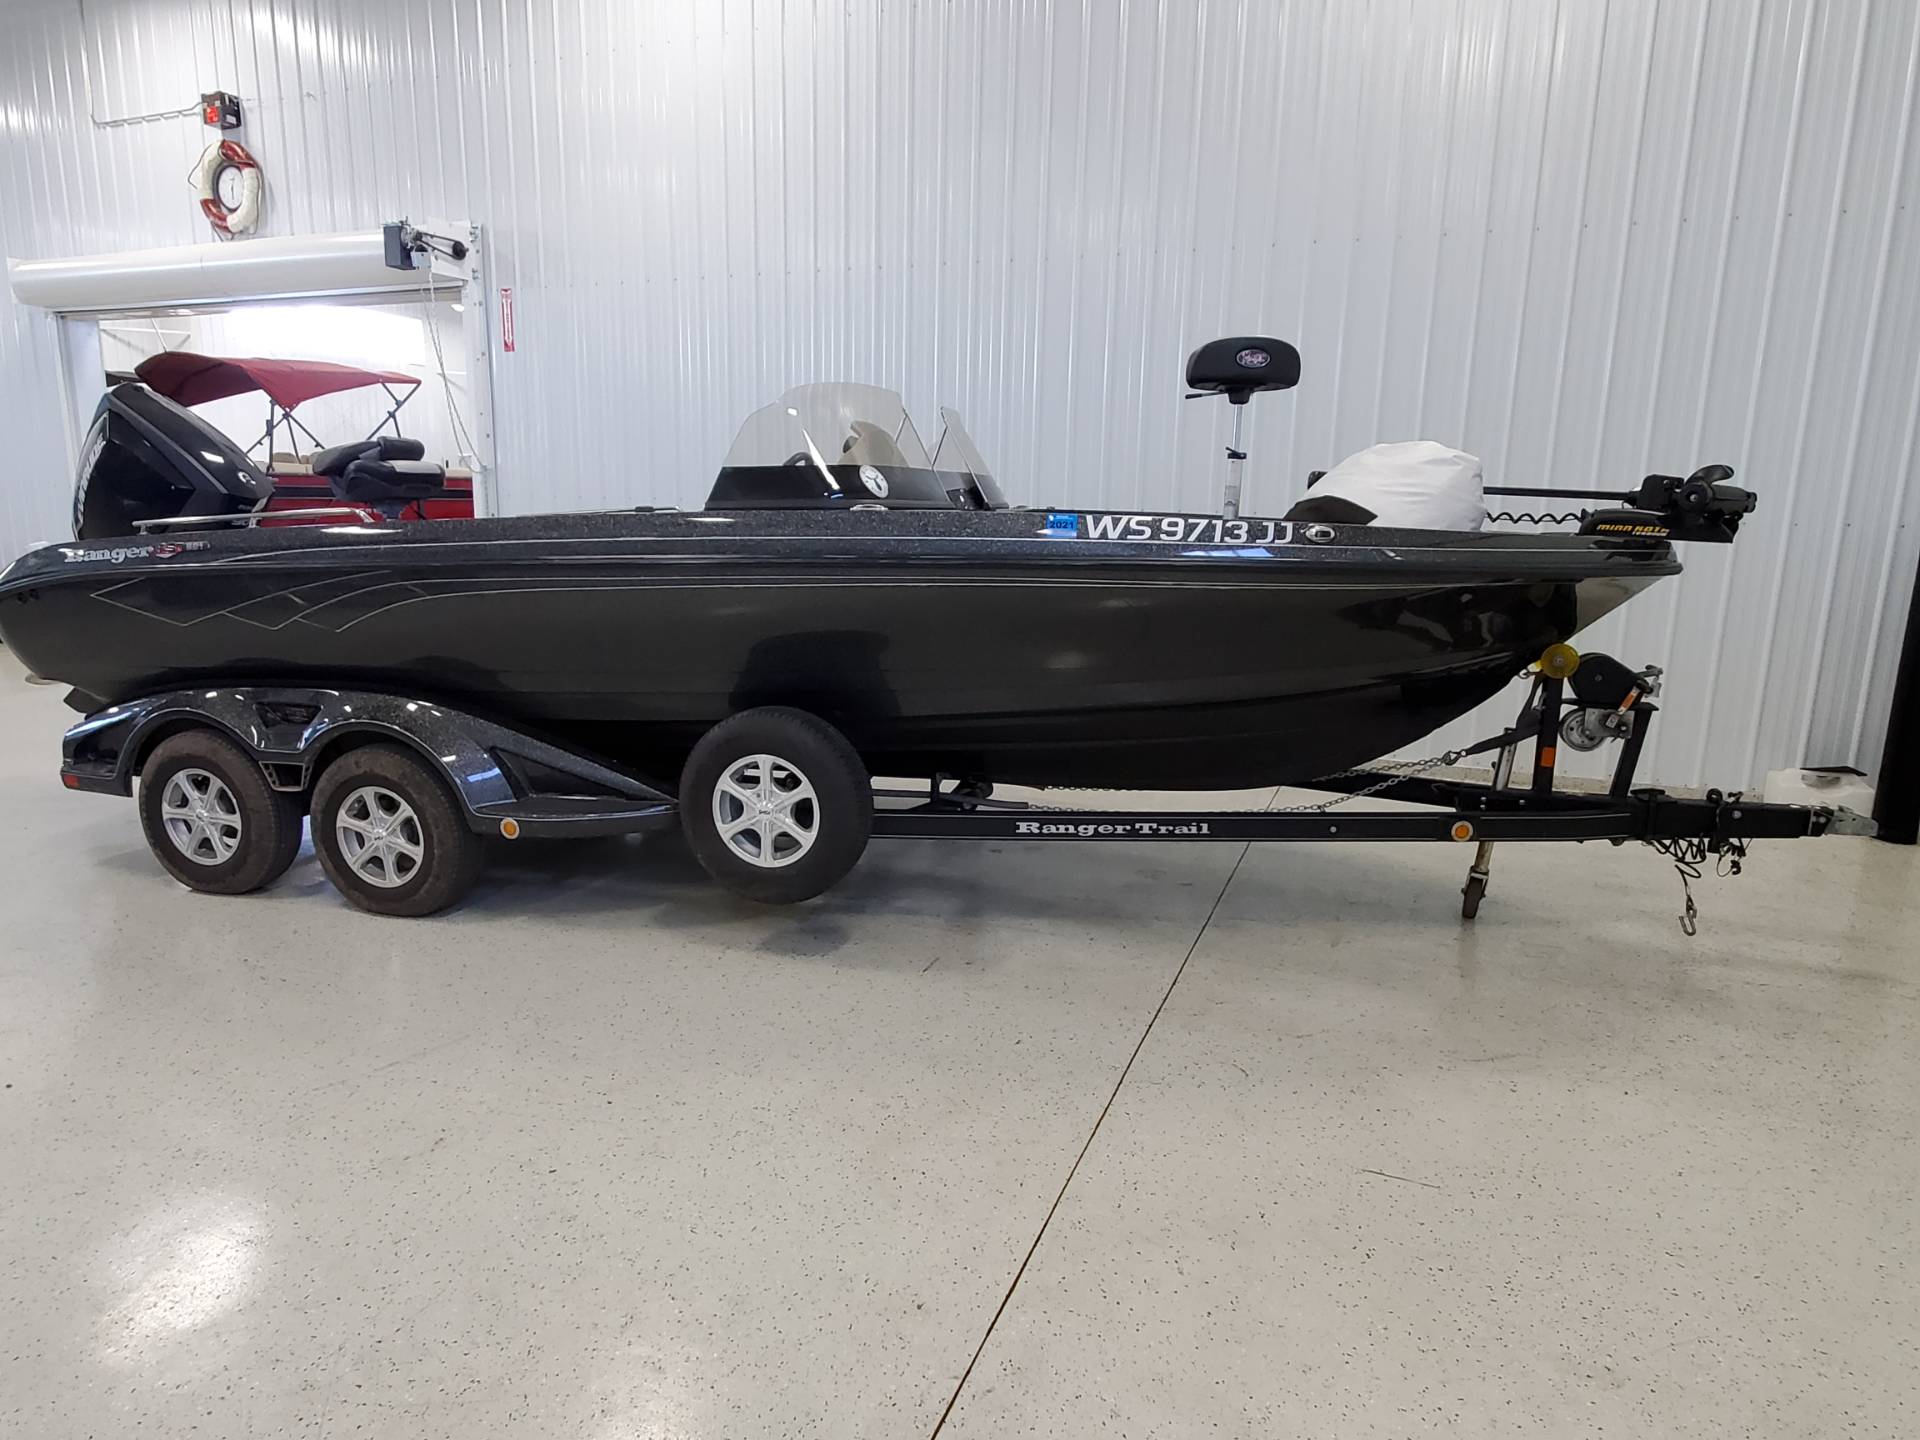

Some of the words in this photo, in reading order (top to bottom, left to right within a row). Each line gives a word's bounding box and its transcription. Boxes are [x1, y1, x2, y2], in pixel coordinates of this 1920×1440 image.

[1049, 520, 1074, 529] 2021
[1086, 514, 1152, 540] WS
[1159, 517, 1248, 544] 9713
[1255, 520, 1295, 544] JJ
[58, 546, 154, 563] Ranger
[1015, 821, 1131, 836] Ranger
[1135, 822, 1211, 834] Trail
